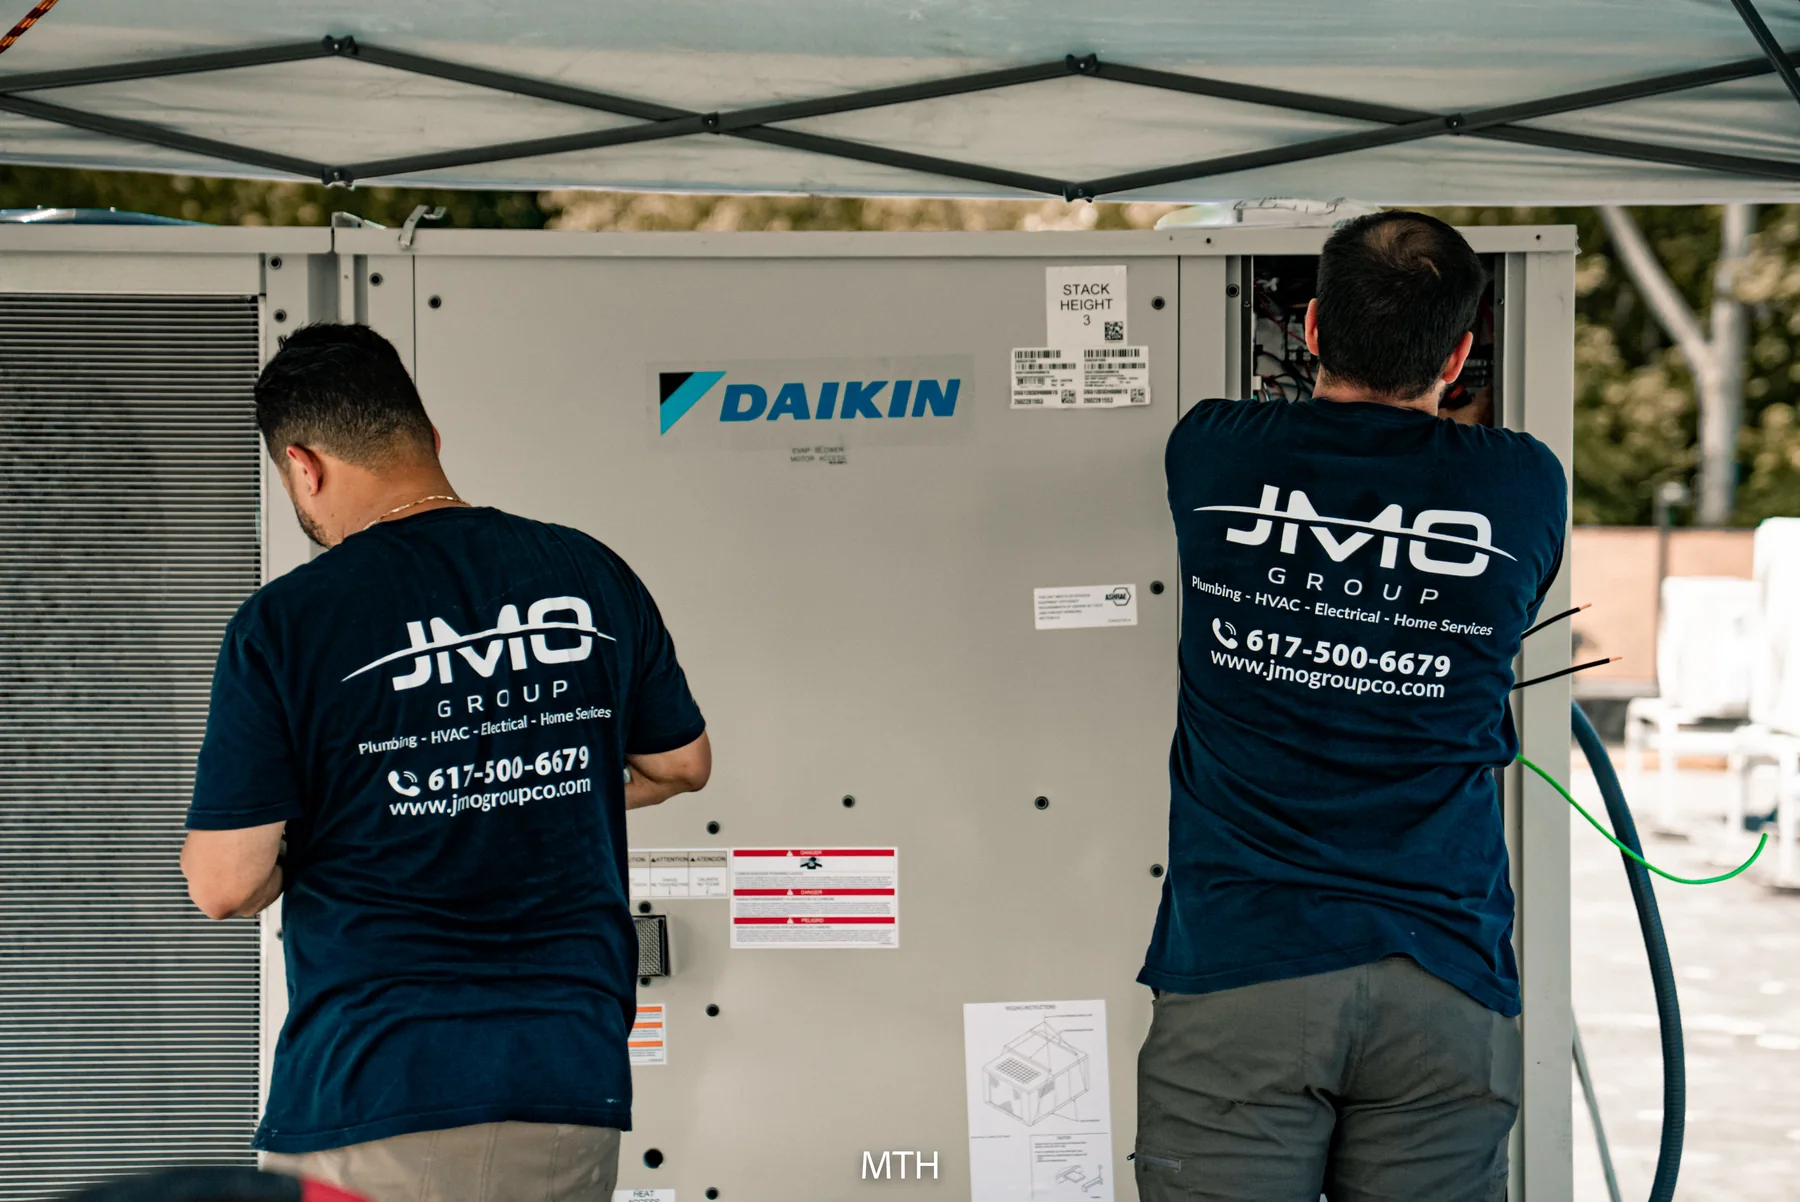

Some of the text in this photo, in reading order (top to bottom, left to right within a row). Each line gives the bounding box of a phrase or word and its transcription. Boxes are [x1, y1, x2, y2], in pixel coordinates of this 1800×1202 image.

[1060, 299, 1113, 311] HEIGHT
[1063, 283, 1110, 296] STACK
[1083, 314, 1091, 326] 3
[719, 378, 961, 422] DAIKIN
[1226, 484, 1492, 577] JMO
[1191, 575, 1242, 602] Plumbing
[1255, 591, 1301, 612] HVAC
[1315, 602, 1380, 624] Electrical
[1394, 613, 1437, 631] Home
[1440, 619, 1493, 637] Services
[1267, 566, 1439, 604] GROUP
[393, 596, 594, 691] JMO
[1246, 629, 1451, 678] 617-500-6679
[1211, 650, 1446, 698] www.jmogroupco.com
[437, 679, 568, 717] GROUP
[358, 735, 418, 755] Plumbing
[431, 726, 470, 744] HVAC
[480, 715, 528, 736] Electrical
[540, 711, 574, 726] Home
[428, 746, 589, 792] 617-500-6679
[389, 777, 591, 817] www.jmogroupco.com
